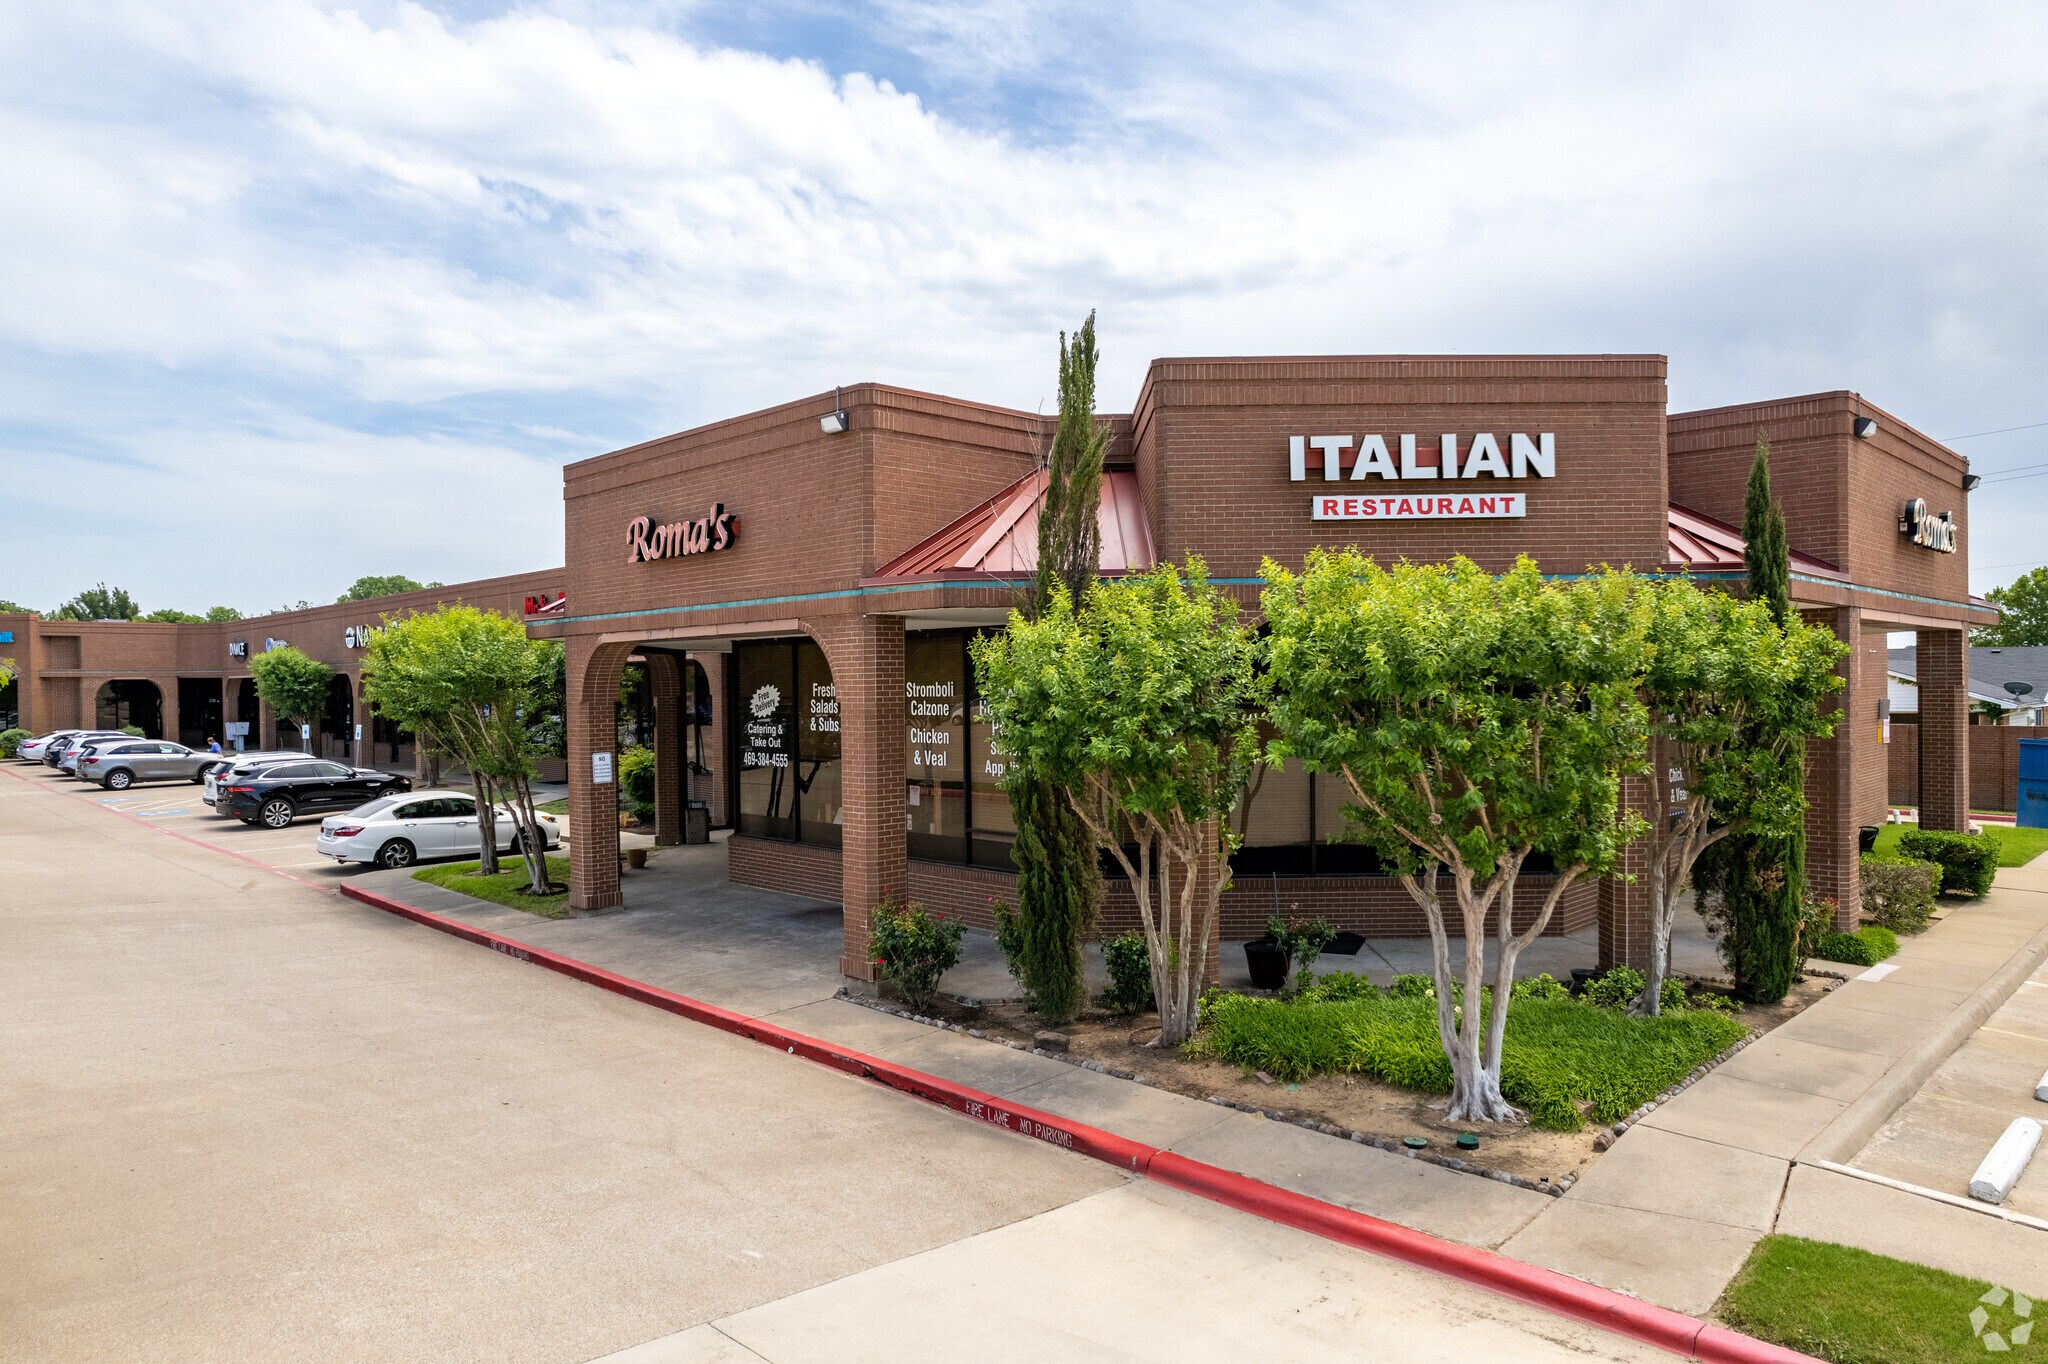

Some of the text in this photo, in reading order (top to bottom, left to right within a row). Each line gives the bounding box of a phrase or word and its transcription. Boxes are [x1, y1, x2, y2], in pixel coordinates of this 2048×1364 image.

[1289, 432, 1556, 482] ITALIAN
[1322, 496, 1516, 516] RESTAURANT
[626, 502, 734, 563] Roma's
[758, 691, 770, 702] Free
[812, 683, 836, 697] Fresh
[906, 682, 954, 698] Stromboli
[754, 698, 776, 714] Delivery
[810, 699, 839, 714] Salads
[910, 700, 949, 716] Calzone
[747, 723, 784, 737] Catering &
[810, 717, 840, 732] & Subs
[750, 736, 781, 748] Take Out
[910, 728, 950, 745] Chicken
[743, 751, 788, 768] 469-384-4555
[913, 750, 947, 766] & Veal
[966, 1100, 1073, 1148] FIRE LANE NO PARKING
